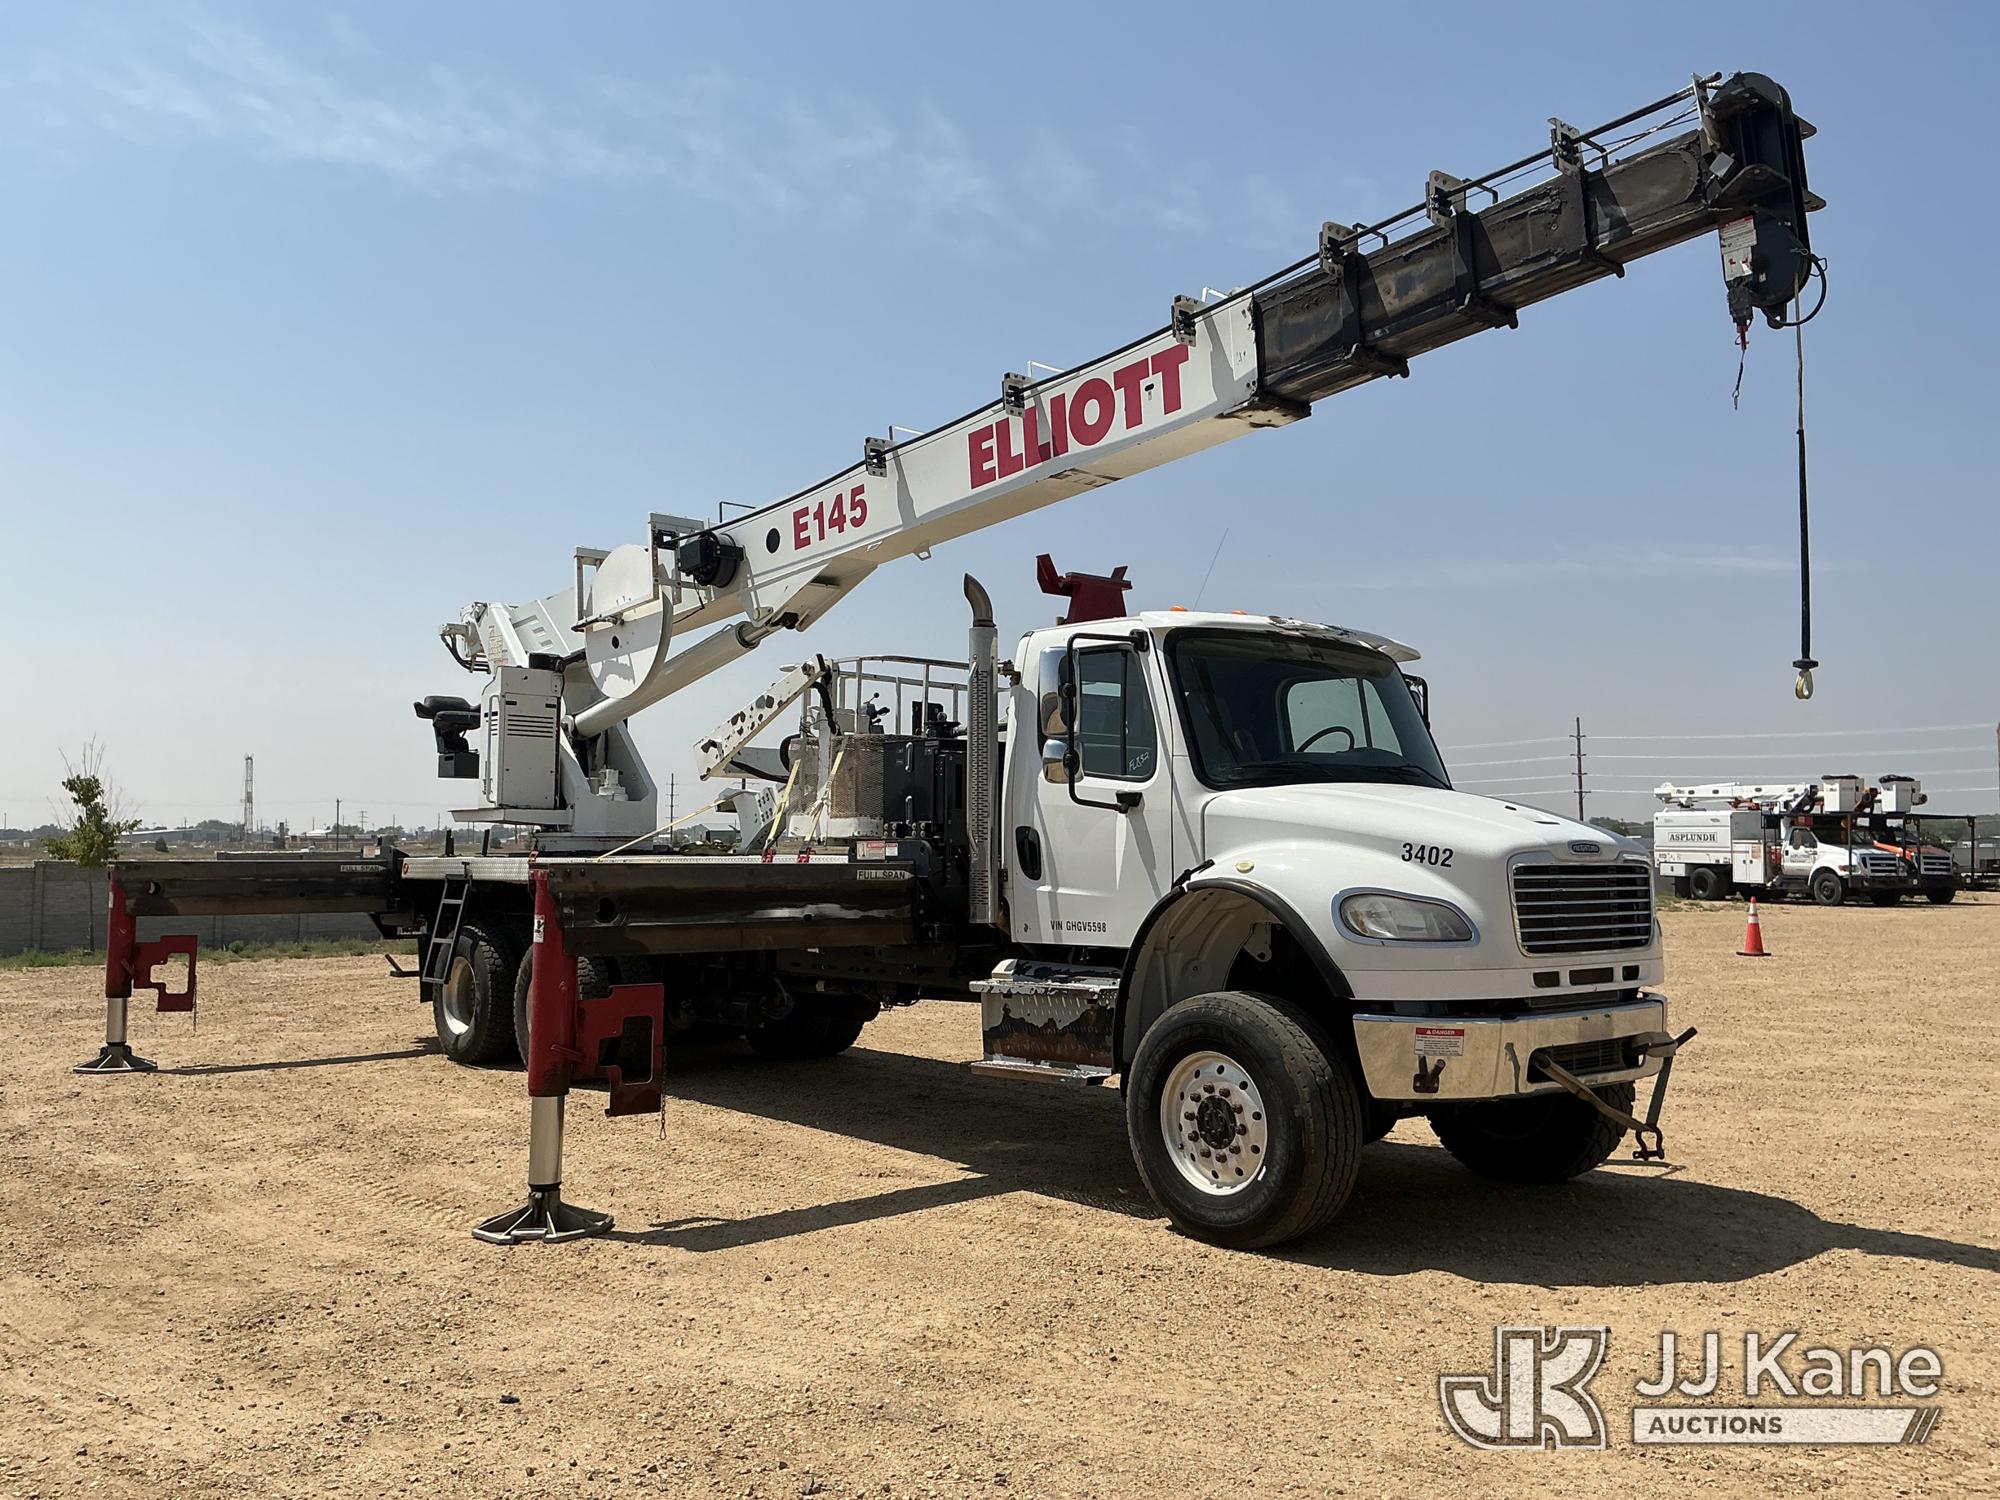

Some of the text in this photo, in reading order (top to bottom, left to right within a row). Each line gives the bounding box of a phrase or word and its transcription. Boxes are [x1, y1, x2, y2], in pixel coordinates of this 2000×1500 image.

[968, 344, 1189, 489] ELLIOTT
[793, 483, 868, 551] E145
[1669, 833, 1716, 841] ASPLUNDH
[1401, 842, 1454, 868] 3402
[858, 870, 905, 880] FULL SPAN
[1050, 920, 1107, 932] VIN GHGV5598
